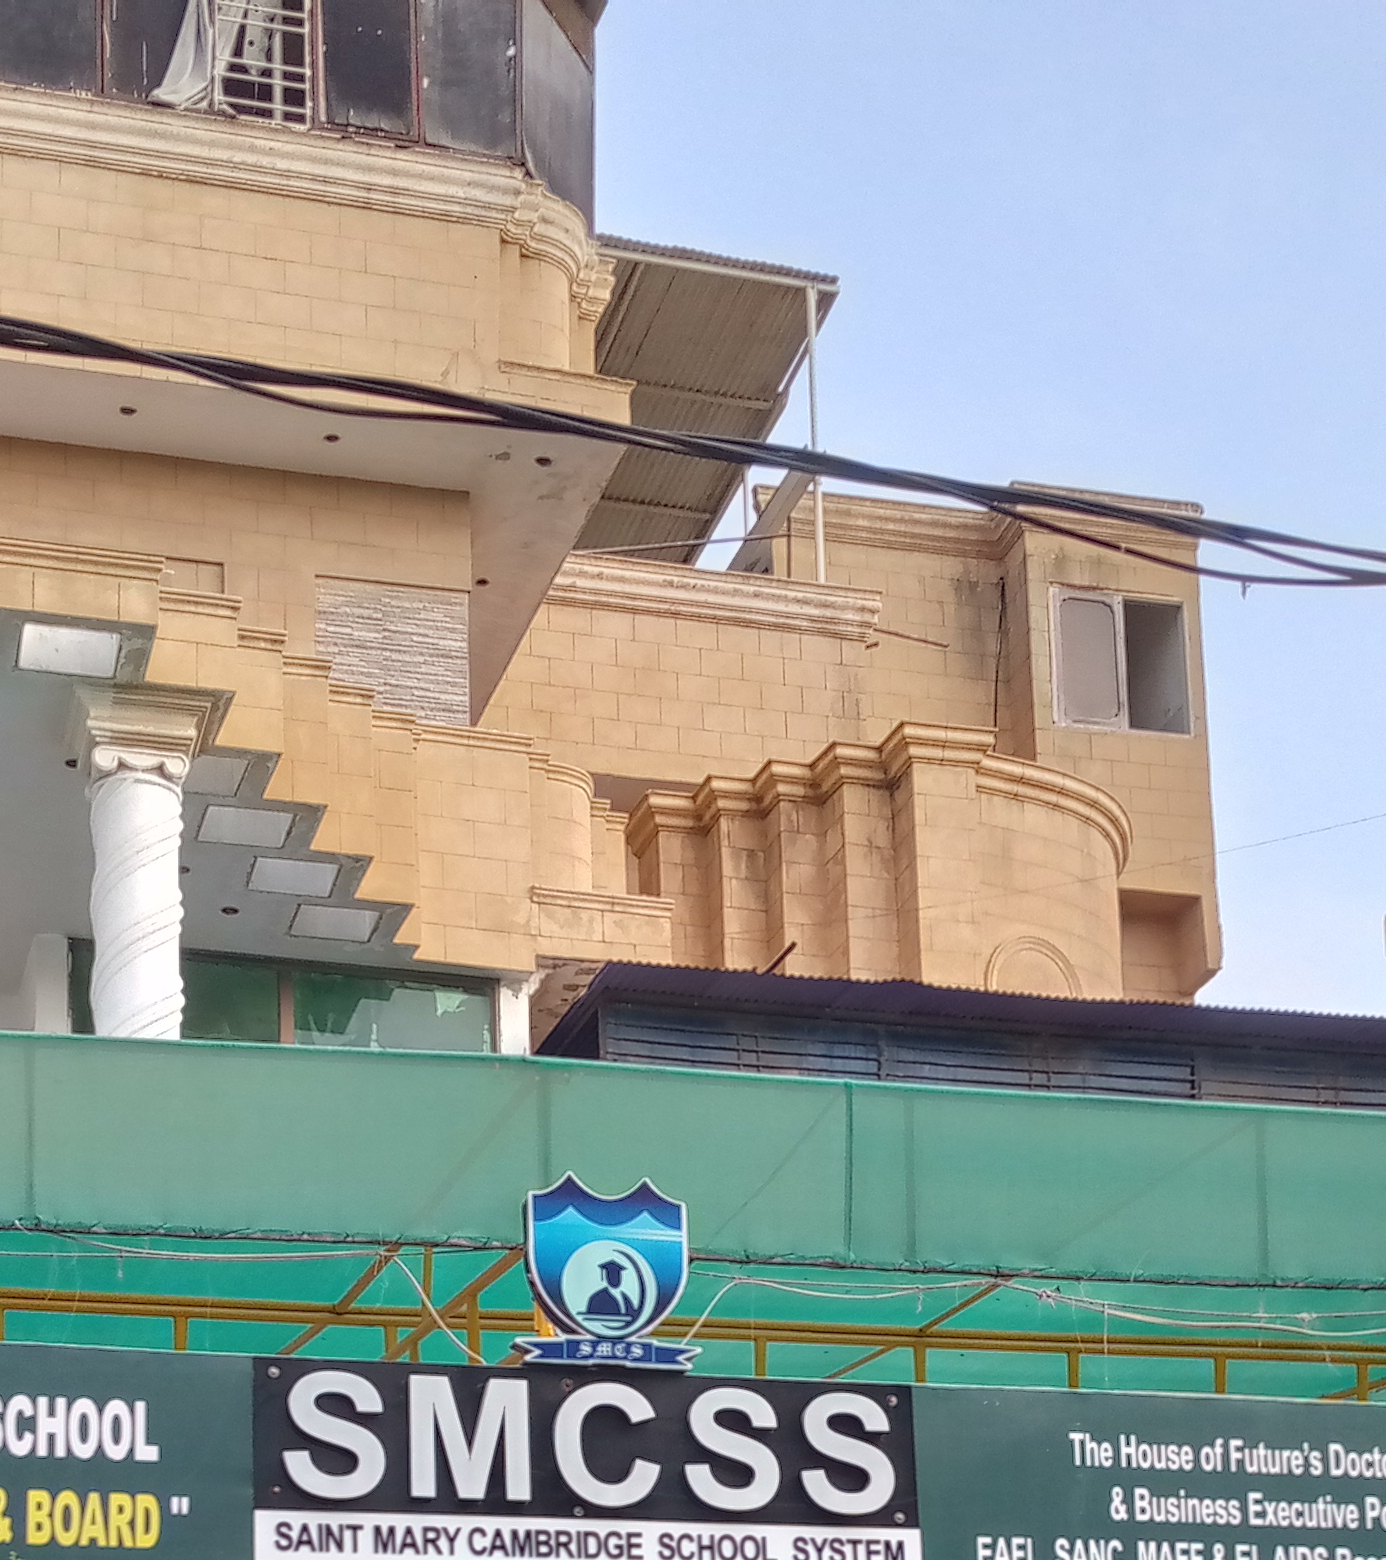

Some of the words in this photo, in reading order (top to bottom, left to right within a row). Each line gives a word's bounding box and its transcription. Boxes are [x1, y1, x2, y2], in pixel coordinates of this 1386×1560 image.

[575, 1341, 645, 1360] SMCS
[280, 1369, 898, 1515] SMCSS
[1068, 1432, 1114, 1468] The
[1119, 1434, 1194, 1471] House
[1200, 1437, 1224, 1472] of
[26, 1489, 162, 1550] BOARD
[1110, 1486, 1129, 1521] &
[1134, 1487, 1242, 1526] Business
[1247, 1492, 1360, 1529] Executive
[274, 1522, 363, 1554] SAINT
[373, 1525, 462, 1556] MARY
[468, 1527, 644, 1560] CAMBRIDGE
